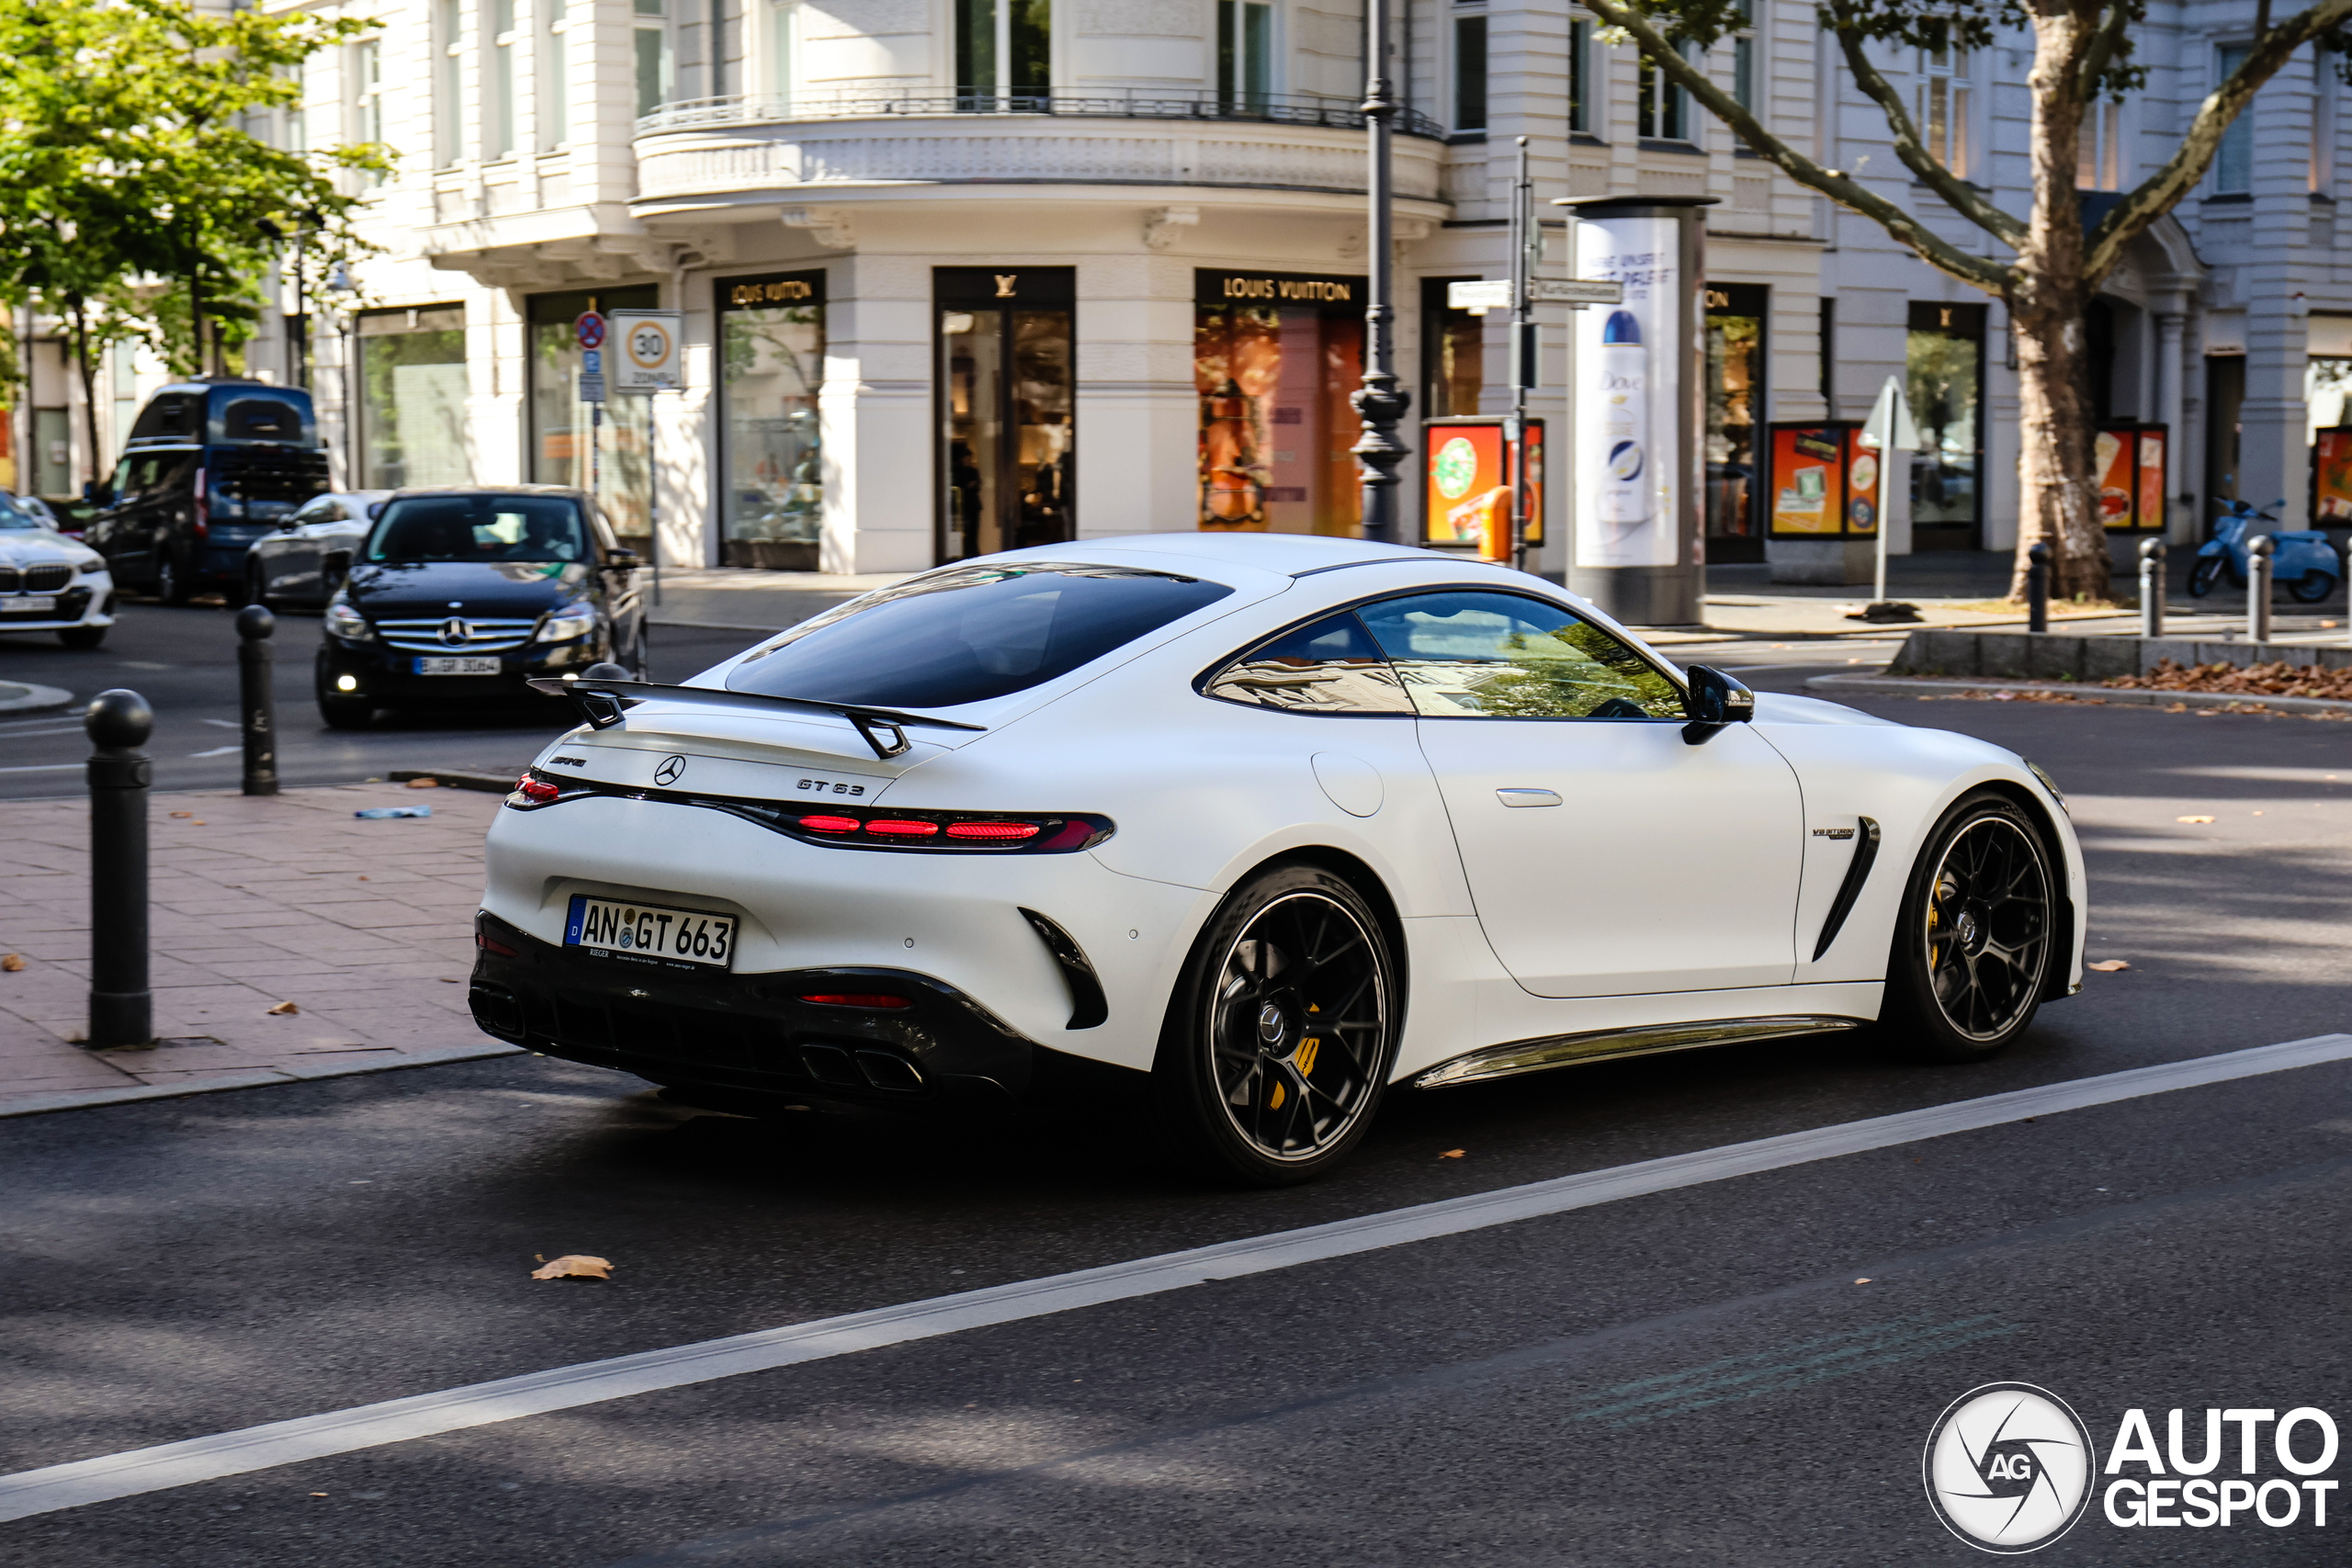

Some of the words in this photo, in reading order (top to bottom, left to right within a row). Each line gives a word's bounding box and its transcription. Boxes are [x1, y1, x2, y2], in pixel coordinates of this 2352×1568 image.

[1224, 277, 1275, 299] LOUIS
[1278, 280, 1351, 301] VUITTON
[634, 333, 663, 356] 30
[797, 779, 830, 792] GT
[832, 783, 865, 796] 63
[571, 926, 578, 937] D
[582, 905, 619, 944] AN
[635, 912, 673, 952] GT
[675, 918, 729, 960] 663
[589, 948, 609, 958] RIEGER
